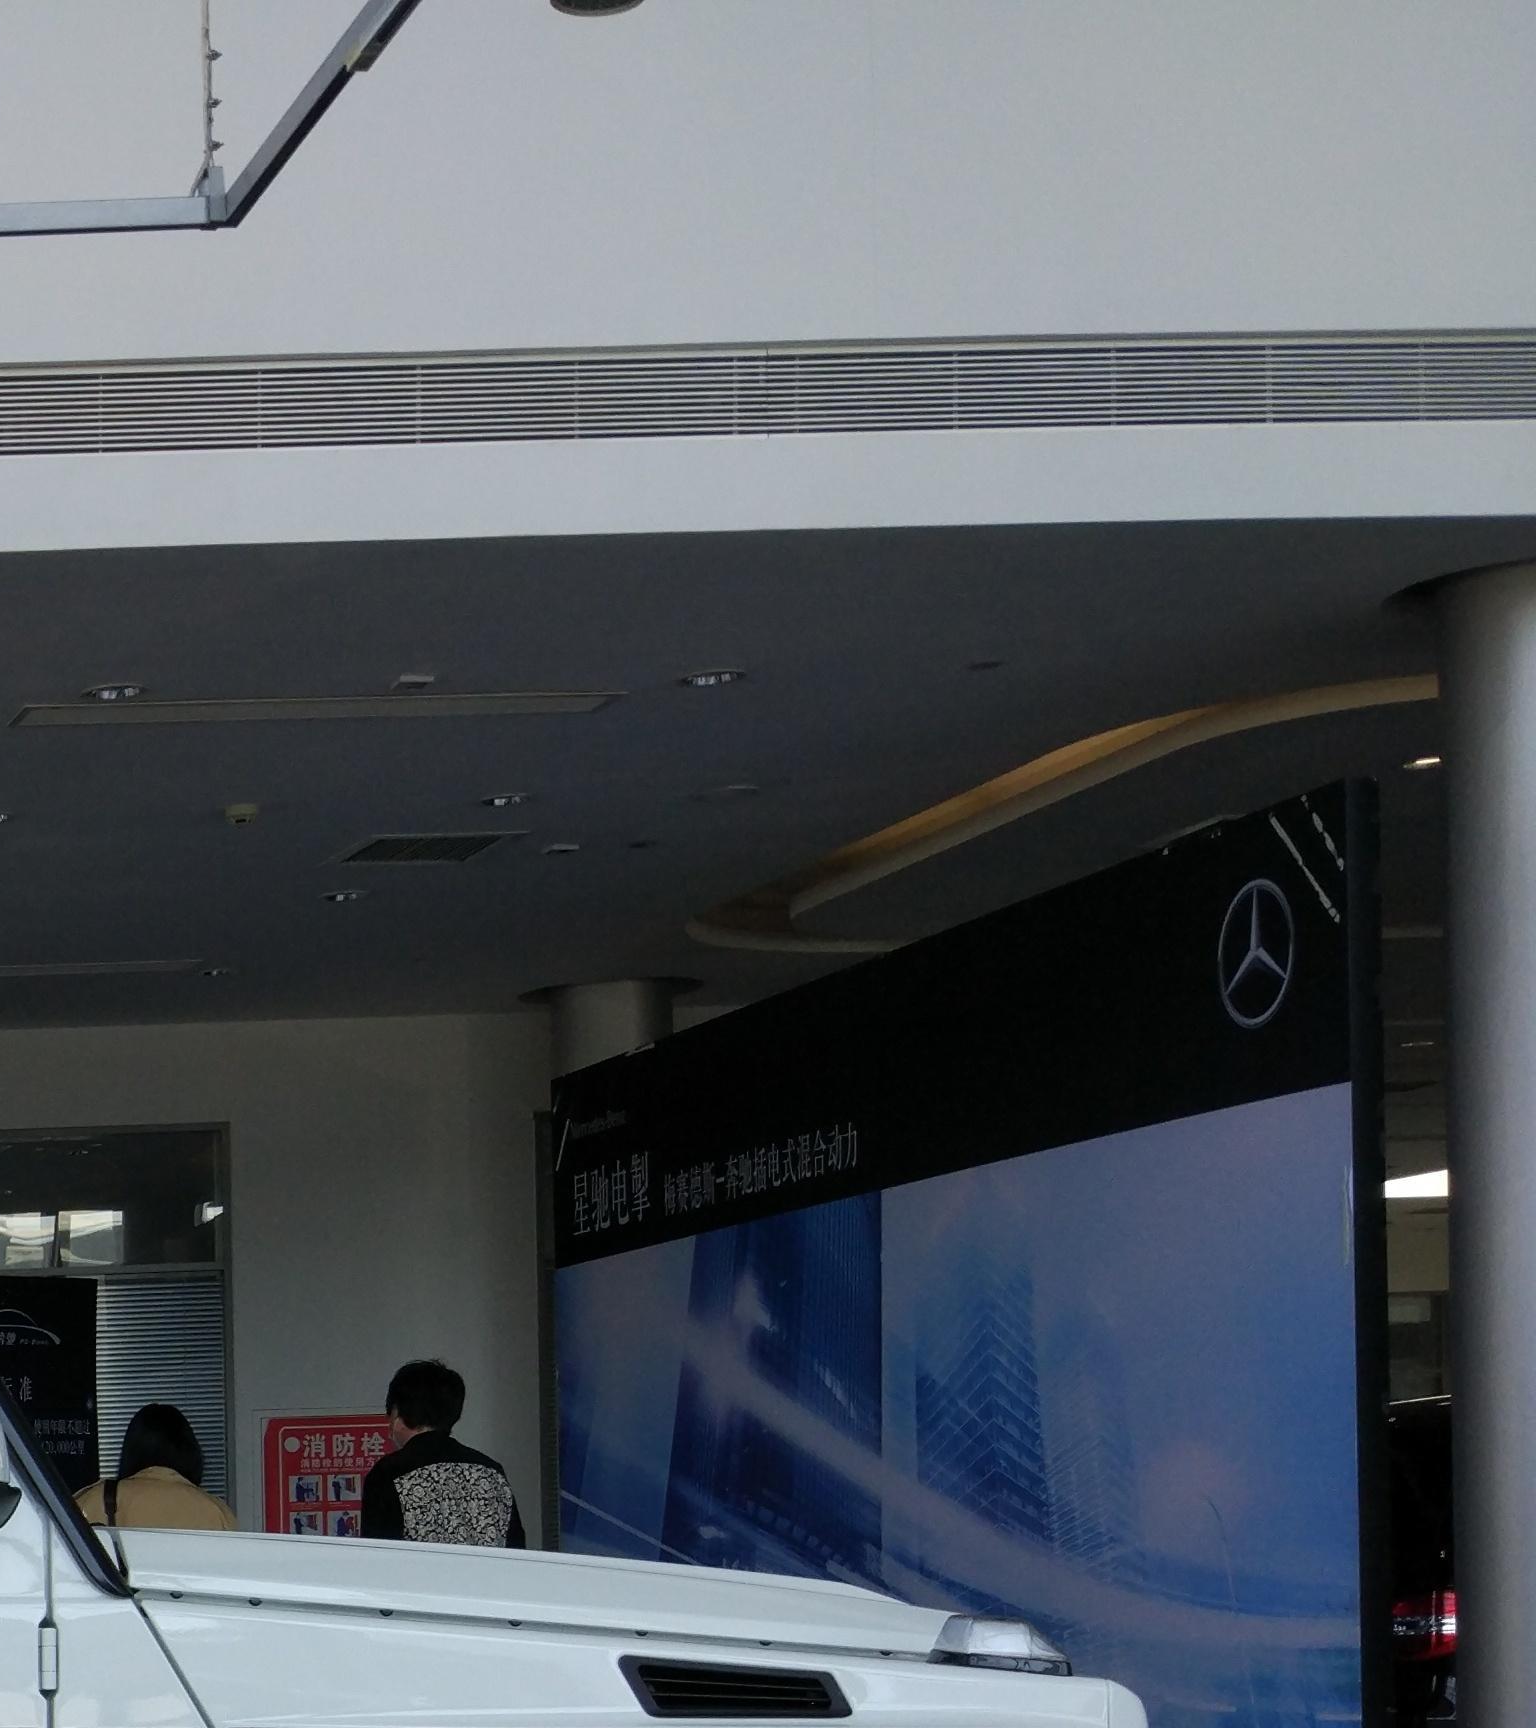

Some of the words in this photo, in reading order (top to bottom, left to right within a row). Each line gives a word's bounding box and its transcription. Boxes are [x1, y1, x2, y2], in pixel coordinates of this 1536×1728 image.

[303, 1432, 386, 1457] 消防栓
[300, 1457, 381, 1469] 消防栓的使用方
